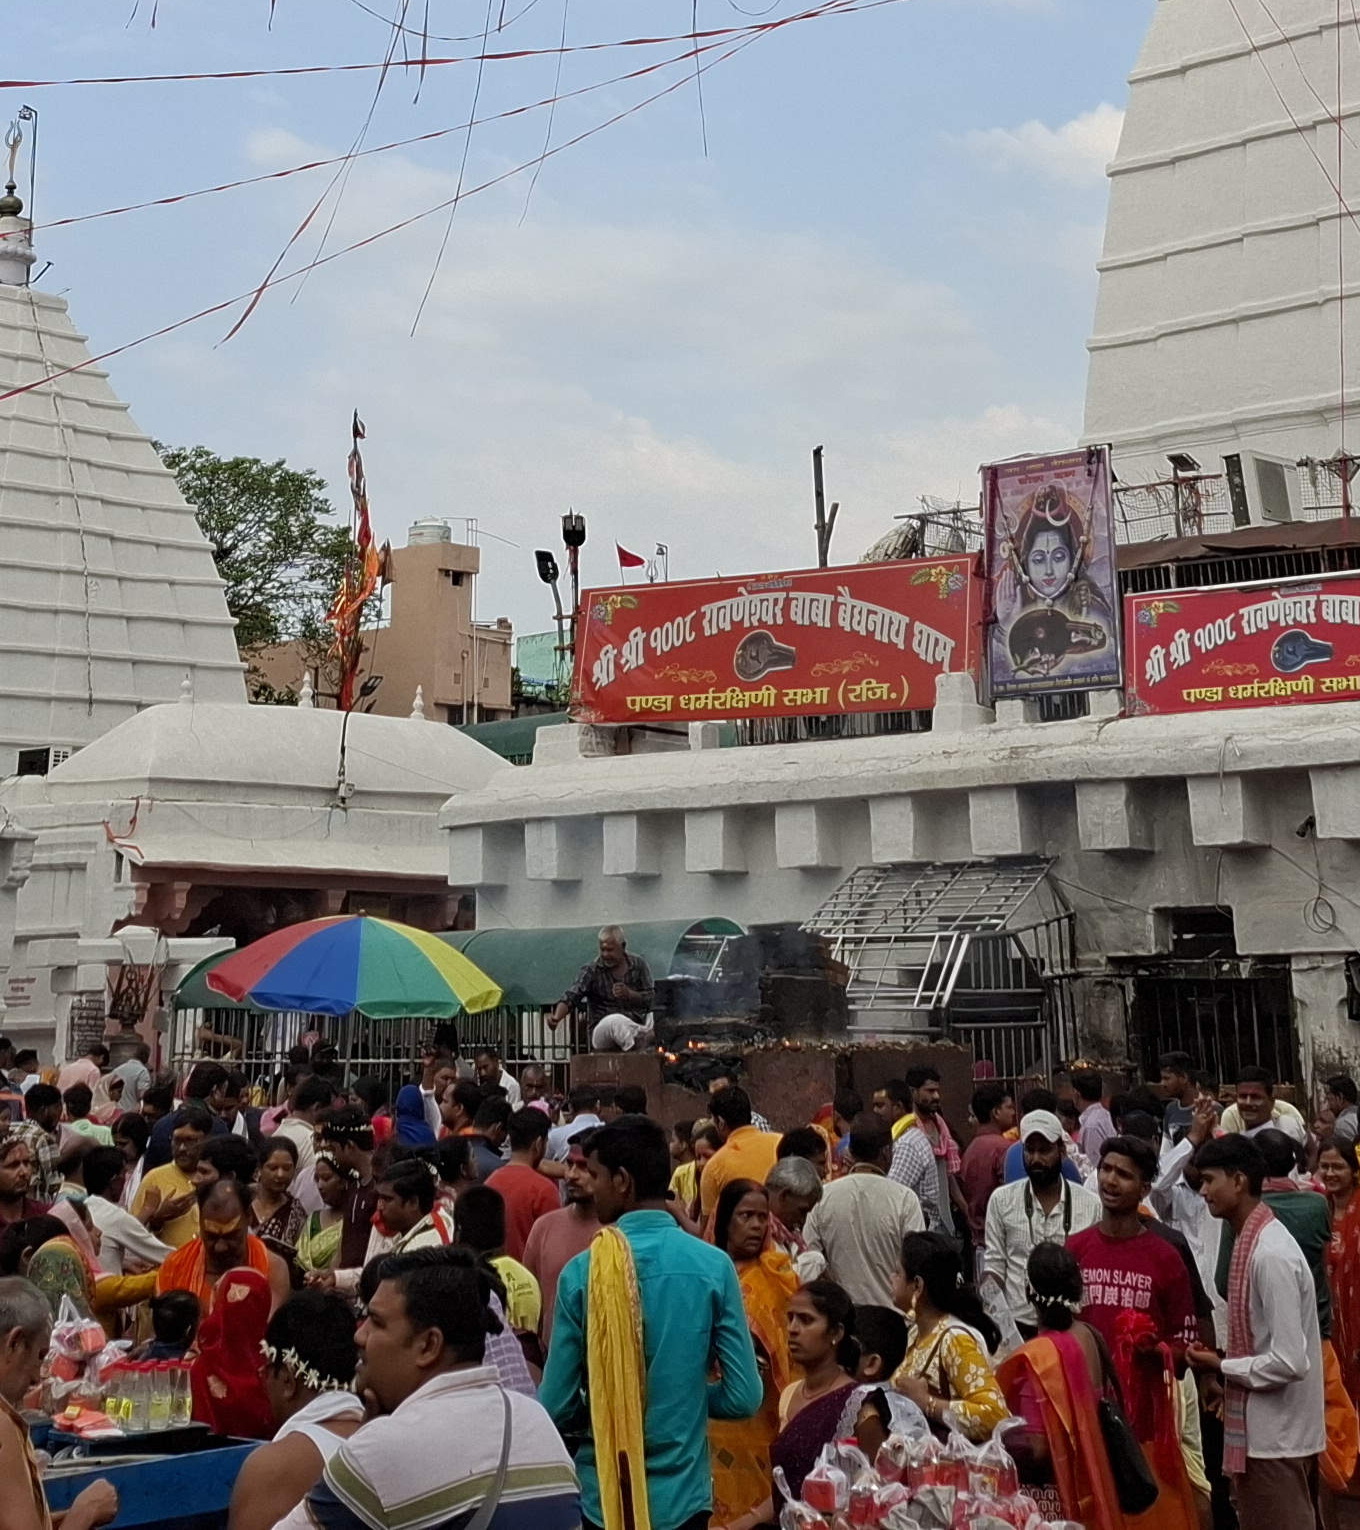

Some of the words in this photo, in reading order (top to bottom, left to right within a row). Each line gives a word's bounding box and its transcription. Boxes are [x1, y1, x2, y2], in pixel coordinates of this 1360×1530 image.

[592, 643, 618, 691] श्री
[620, 626, 647, 673] श्री
[650, 609, 697, 656] १००८
[701, 586, 787, 636] रावणेश्वर
[789, 591, 835, 628] बाबा
[837, 585, 909, 650] बैद्यनाथ
[912, 620, 956, 674] धाम
[1145, 644, 1167, 687] श्री
[1169, 628, 1191, 670] श्री
[1194, 612, 1236, 654] १००८
[1239, 591, 1318, 635] रावणेश्वर
[626, 694, 674, 713] पण्डा
[679, 684, 778, 711] धर्मरक्षिणी
[782, 686, 830, 707] सभा
[1182, 686, 1224, 703] पण्डा
[1228, 674, 1315, 700] धर्मरक्षिणी
[1081, 1268, 1111, 1284] EMON
[1112, 1269, 1153, 1290] SLAYER
